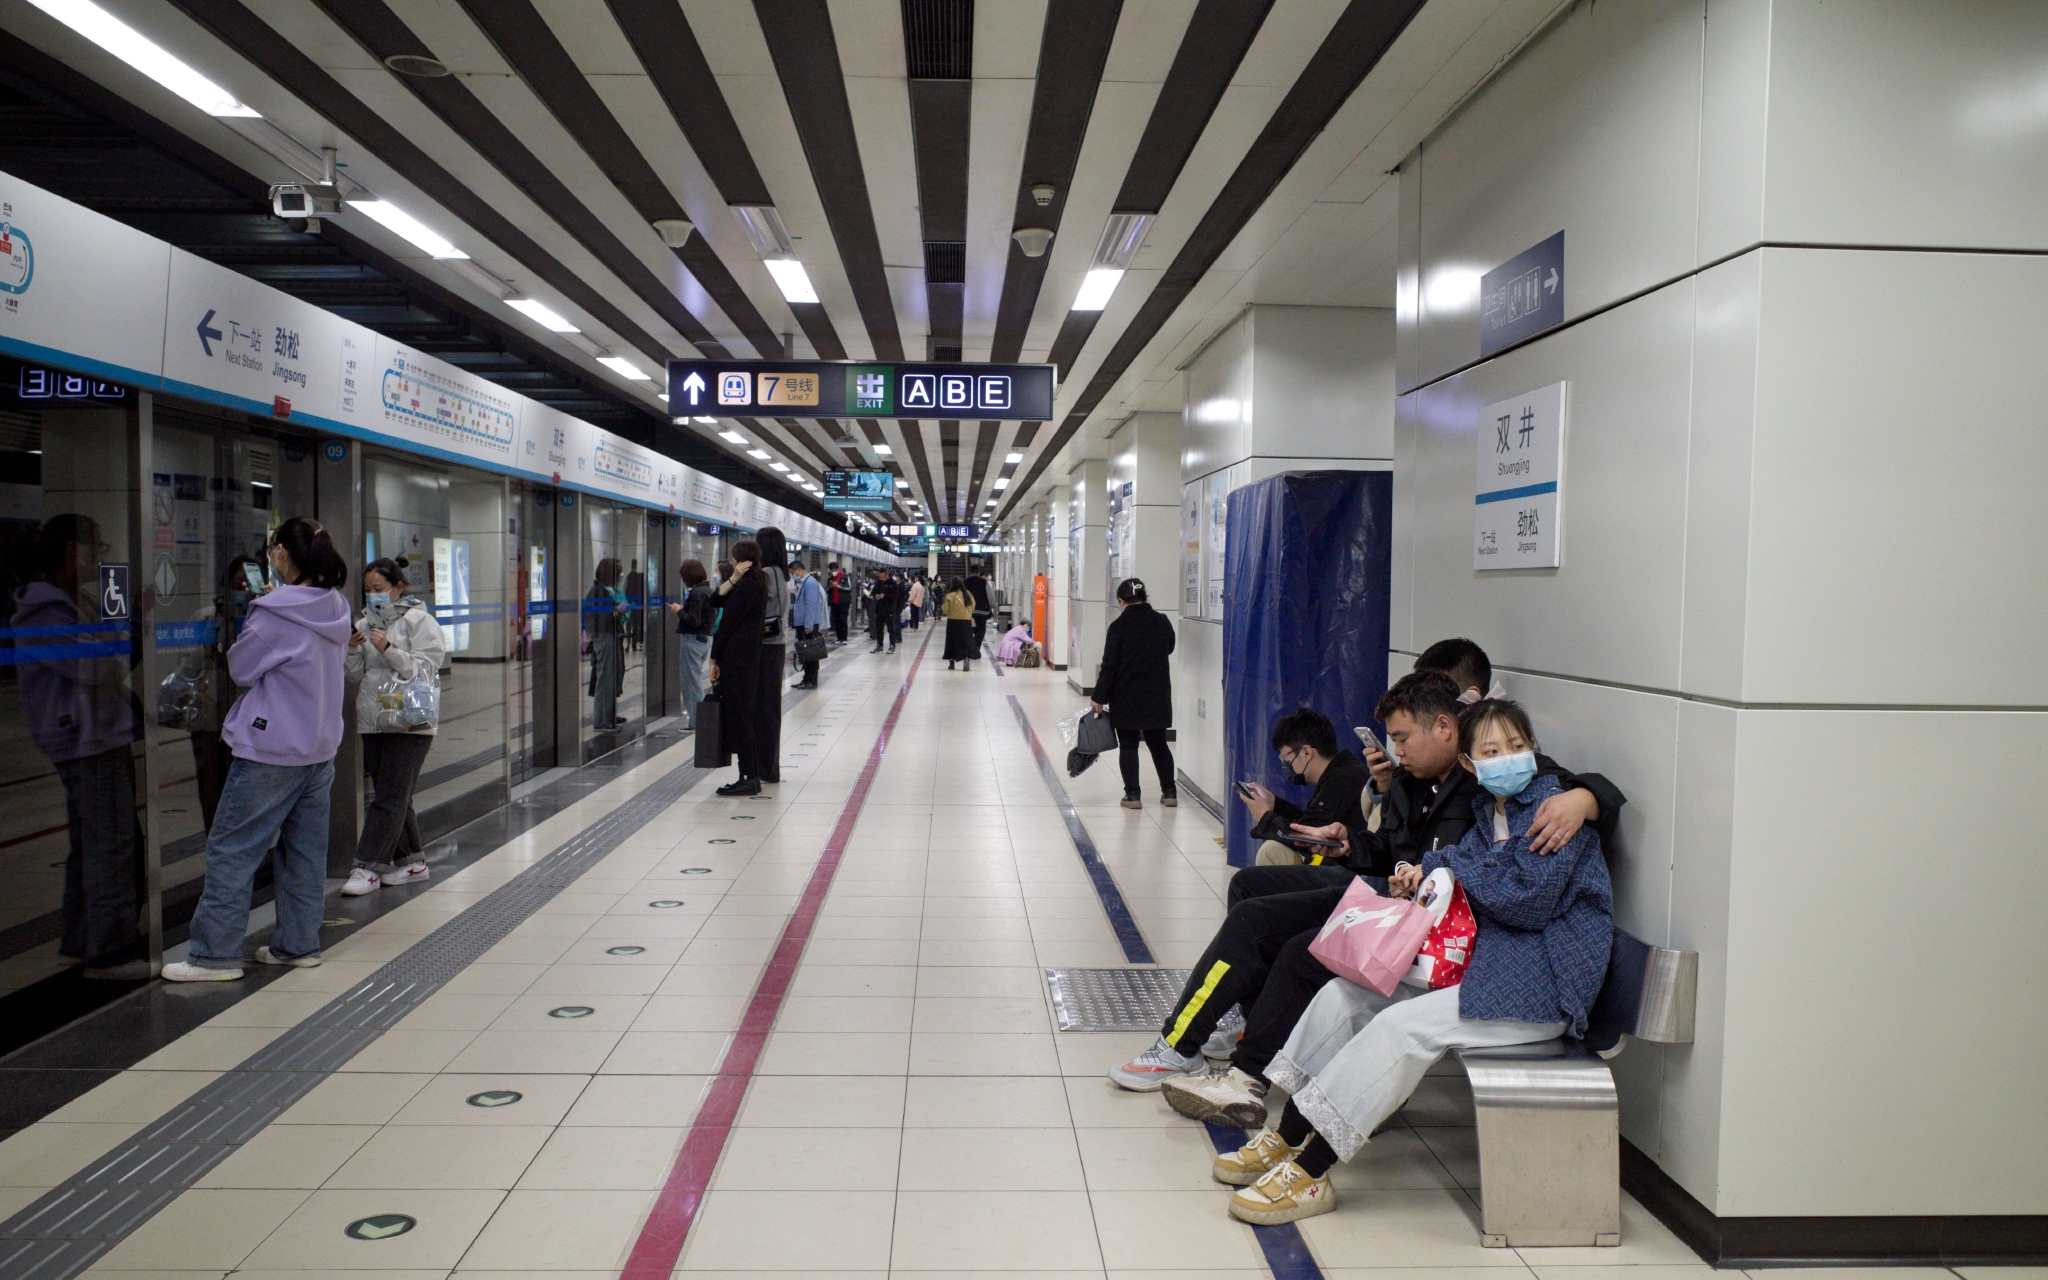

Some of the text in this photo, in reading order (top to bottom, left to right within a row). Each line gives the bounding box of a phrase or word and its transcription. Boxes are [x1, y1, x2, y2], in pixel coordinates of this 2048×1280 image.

[1484, 286, 1506, 317] 卫生间
[1490, 314, 1506, 331] Toilet
[228, 319, 300, 360] 下一站 劲松
[225, 348, 264, 373] Next Station
[272, 361, 307, 389] Jingsong
[763, 376, 814, 402] 7 号线
[787, 393, 810, 401] Line 7
[907, 379, 1004, 404] A B E
[856, 399, 884, 409] EXIT
[1496, 405, 1535, 455] 双井
[327, 445, 344, 458] 09
[1497, 457, 1531, 476] Shuangjing
[562, 496, 574, 504] 10
[1516, 507, 1540, 538] 劲松
[1480, 529, 1497, 545] 下一站
[1517, 540, 1537, 554] Jingsong
